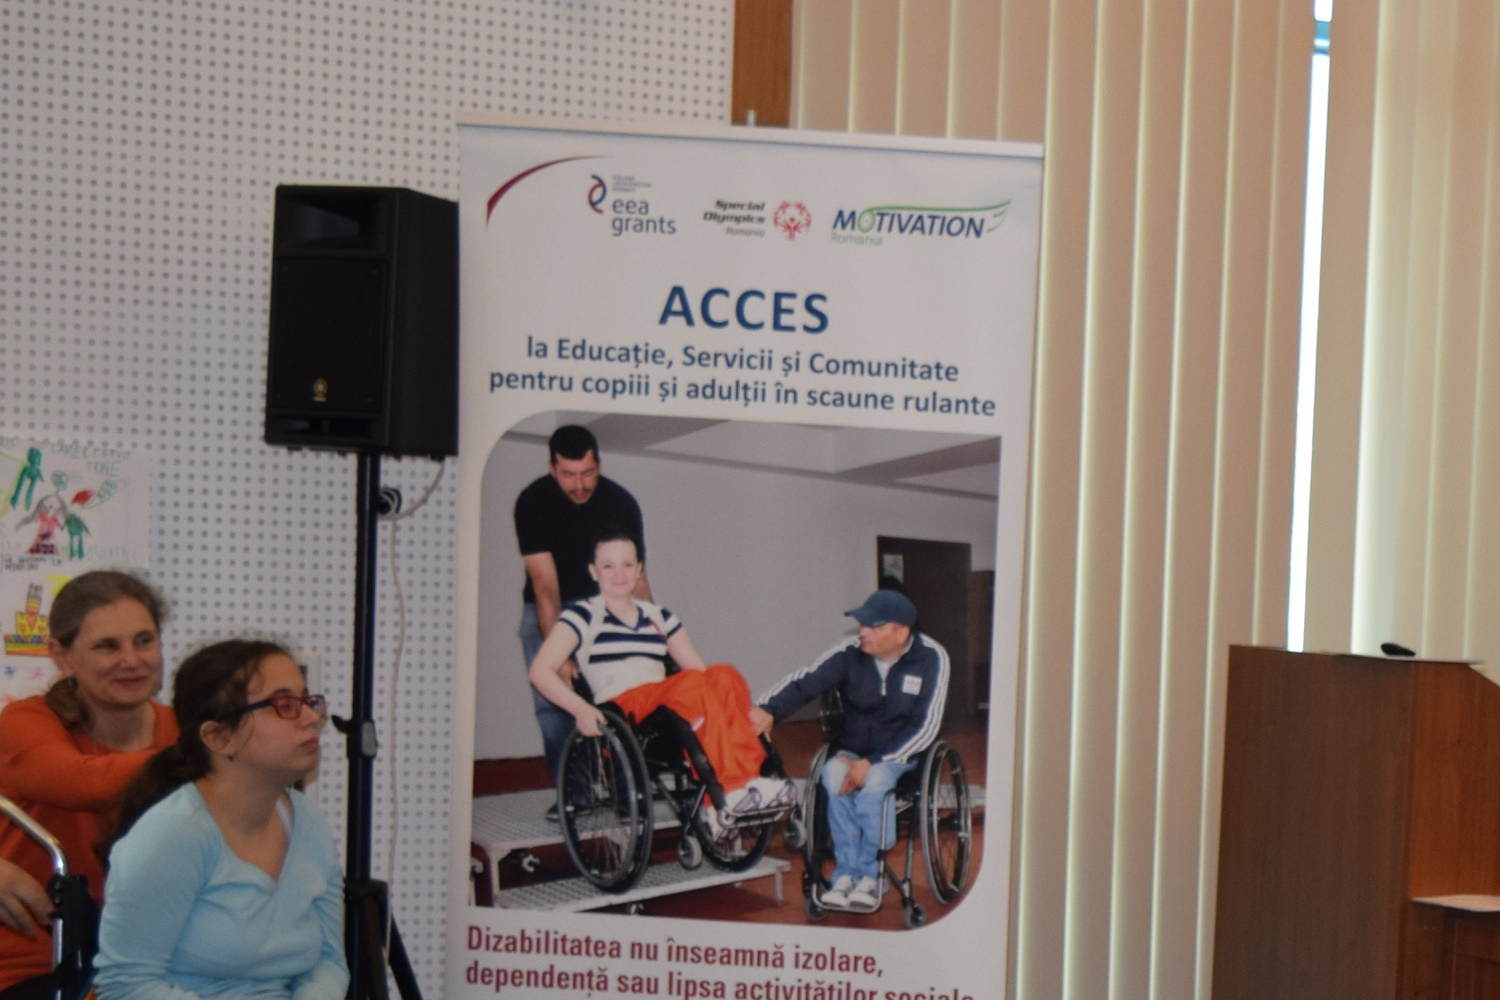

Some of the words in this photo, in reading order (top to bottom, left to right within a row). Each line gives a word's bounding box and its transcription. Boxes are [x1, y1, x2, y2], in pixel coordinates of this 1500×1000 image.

[612, 199, 649, 215] eea
[703, 211, 766, 225] Olympics
[715, 199, 765, 212] Special
[612, 215, 677, 237] grants
[832, 208, 985, 239] MOTIVATION
[658, 285, 829, 334] ACCES
[527, 335, 548, 358] la
[557, 338, 674, 369] Educație,
[682, 345, 773, 371] Servicii
[781, 351, 800, 377] și
[809, 352, 959, 382] Comunitate
[489, 370, 573, 393] pentru
[582, 374, 650, 399] copiii
[659, 376, 678, 402] și
[686, 378, 767, 407] adulții
[775, 381, 798, 404] în
[806, 388, 895, 410] scaune
[903, 391, 996, 416] rulante
[467, 925, 622, 959] Dizabilitatea
[630, 940, 659, 961] nu
[666, 936, 785, 968] înseamnă
[794, 944, 883, 978] izolare,
[466, 960, 608, 998] dependență
[617, 973, 659, 995] sau
